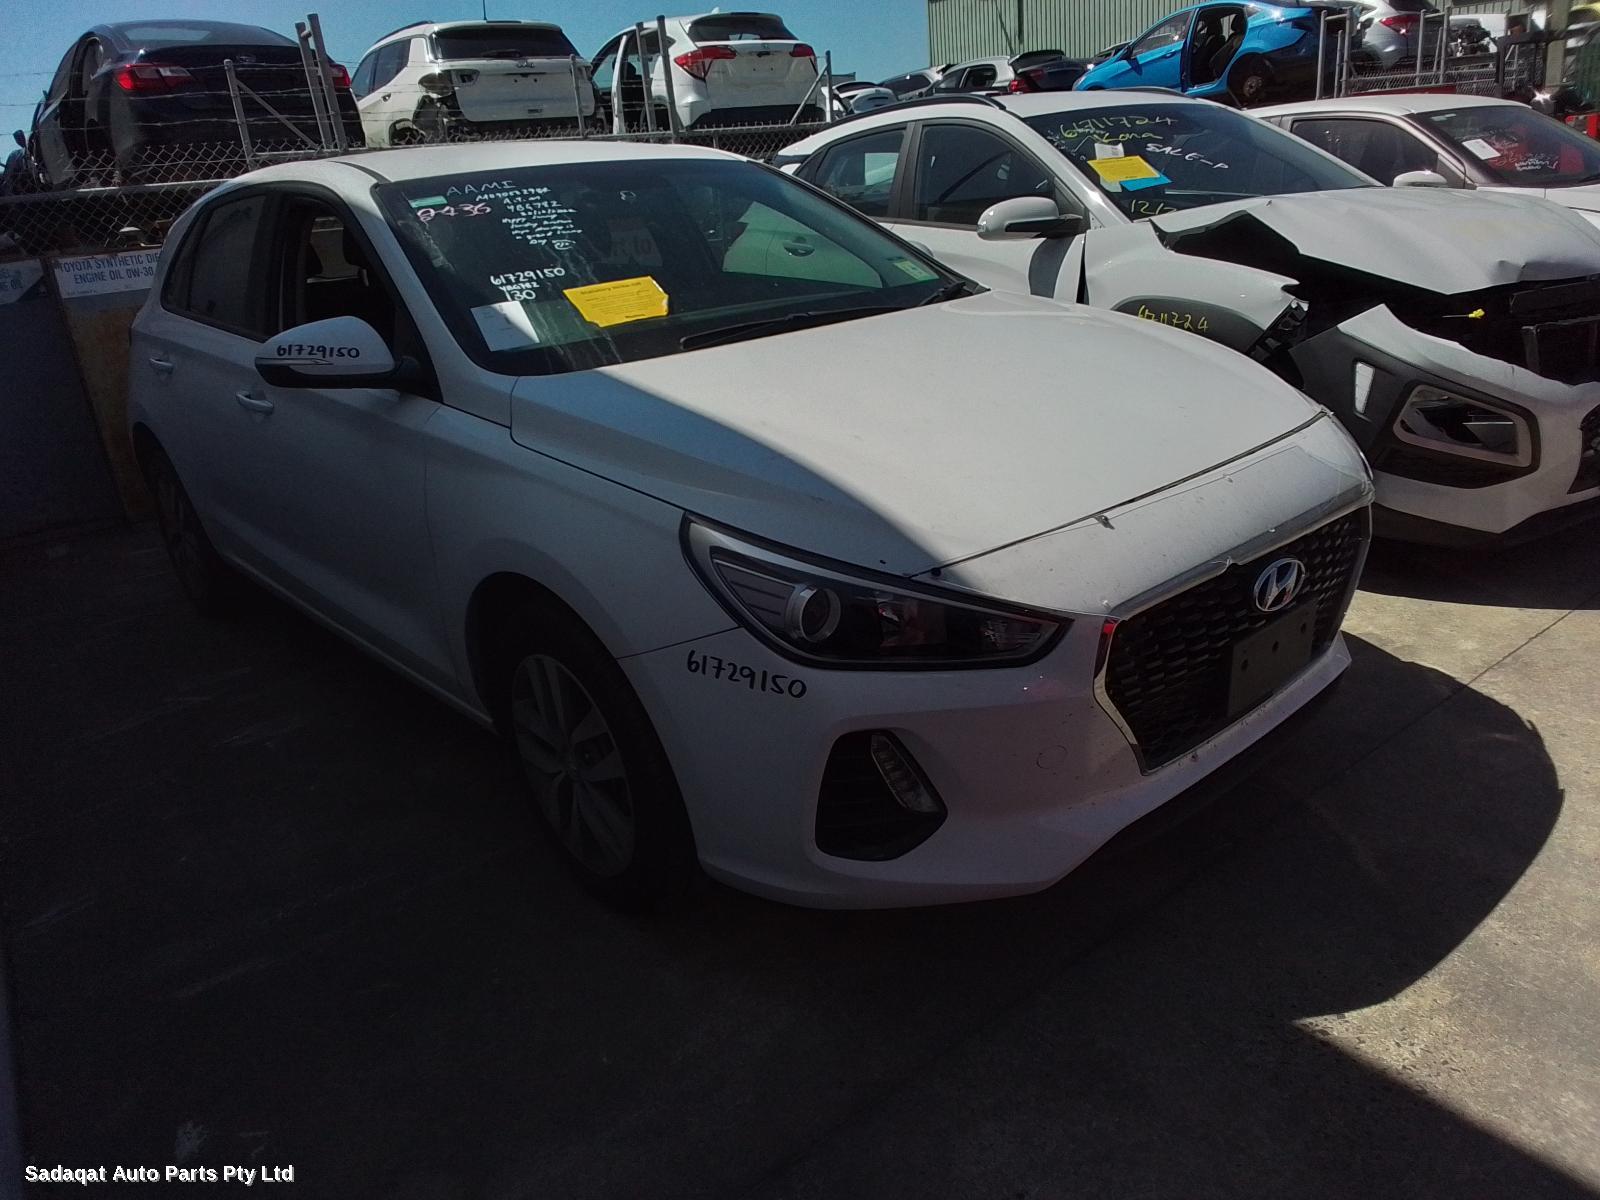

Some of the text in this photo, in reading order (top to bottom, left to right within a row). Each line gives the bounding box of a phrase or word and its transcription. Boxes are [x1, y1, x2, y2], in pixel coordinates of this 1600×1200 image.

[60, 261, 93, 273] TOYOTA
[94, 256, 144, 269] SYNTHETIC
[73, 266, 154, 284] ENGINE OIL 0W-30
[490, 267, 565, 285] 61729150
[276, 344, 361, 359] 61729150
[687, 650, 807, 699] 61729150
